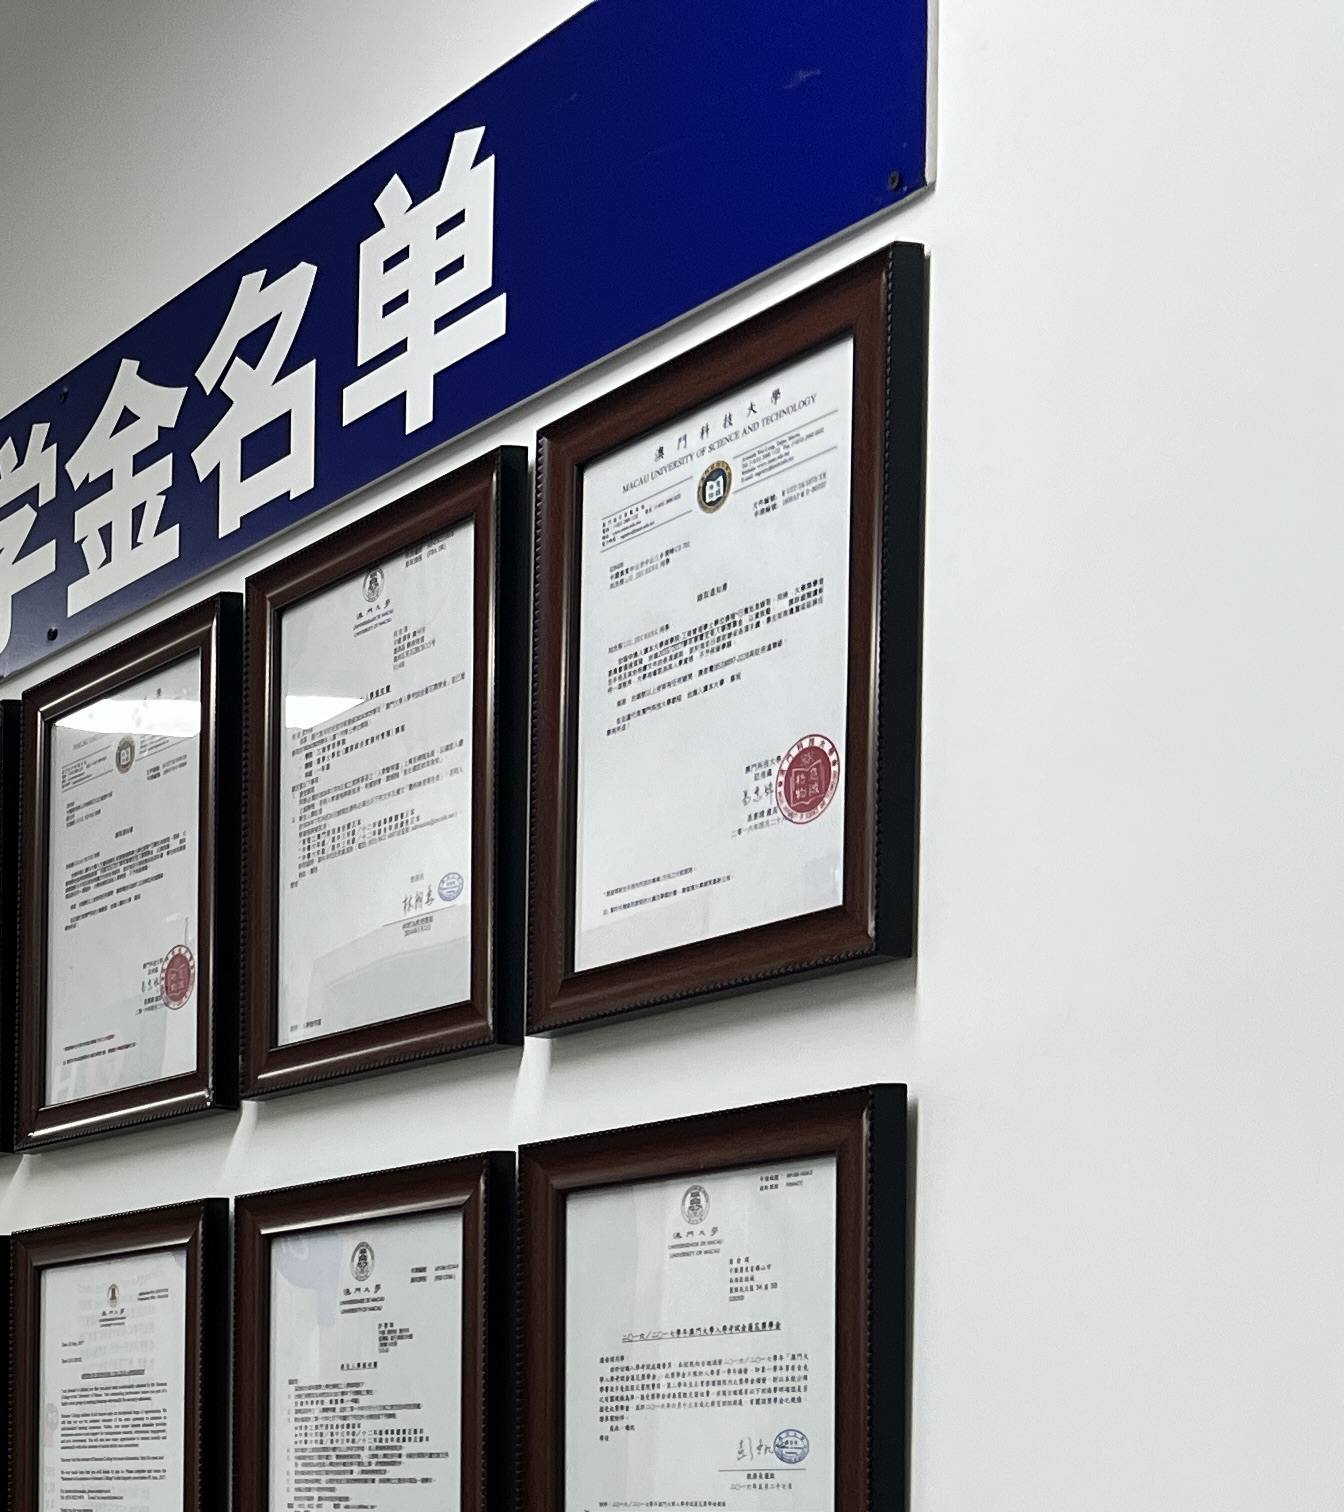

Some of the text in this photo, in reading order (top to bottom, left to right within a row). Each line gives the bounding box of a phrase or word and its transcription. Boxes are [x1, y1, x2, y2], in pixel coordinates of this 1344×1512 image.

[622, 393, 818, 494] MACAU UNIVERSITY OF SCIENCE AND TECHNOLOGY
